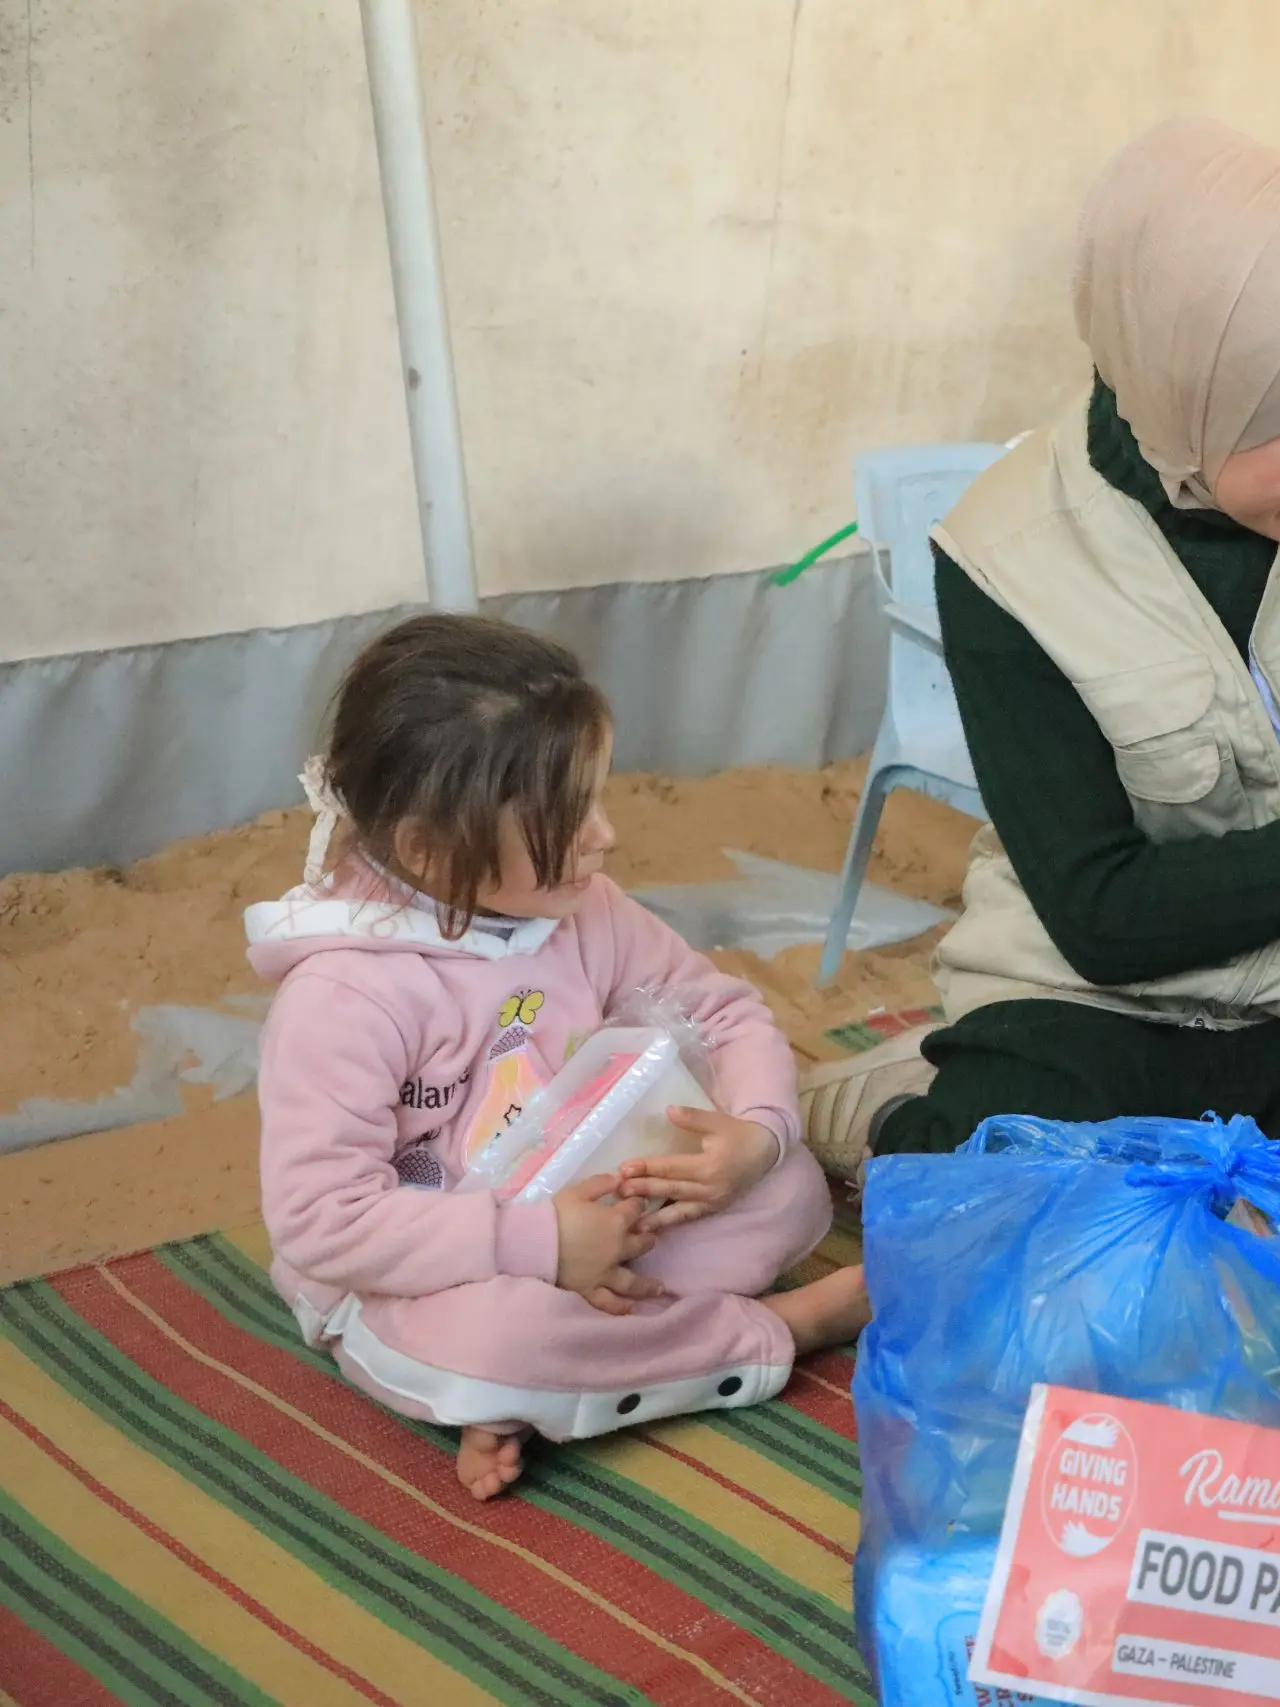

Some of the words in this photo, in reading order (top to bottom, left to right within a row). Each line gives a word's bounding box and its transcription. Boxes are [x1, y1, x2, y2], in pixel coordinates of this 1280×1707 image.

[1060, 1448, 1129, 1487] GIVING
[1050, 1483, 1123, 1522] HANDS
[1136, 1540, 1245, 1606] FOOD
[1117, 1645, 1155, 1667] GAZA
[1169, 1651, 1237, 1679] PALESTINE
